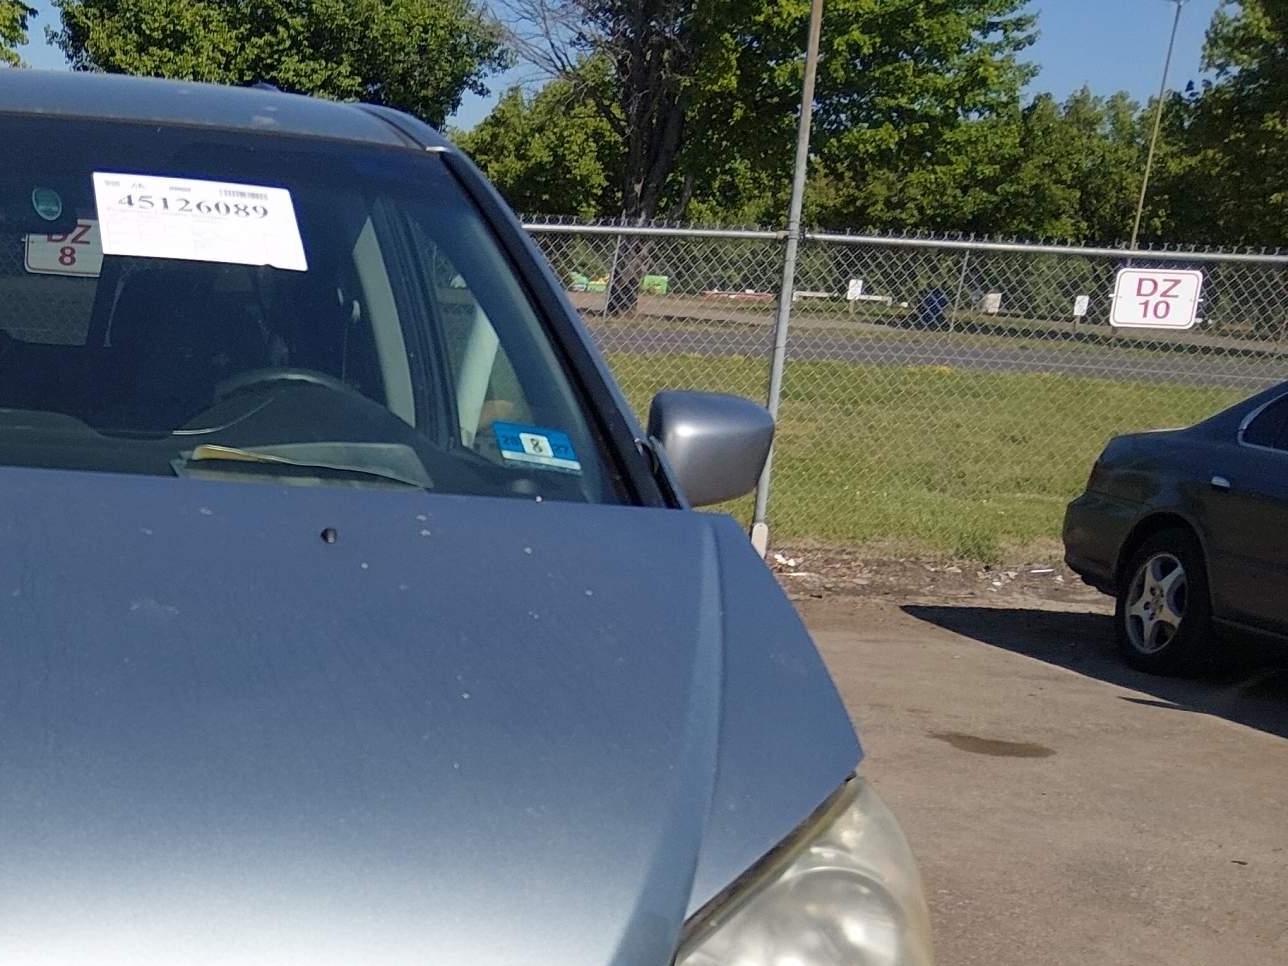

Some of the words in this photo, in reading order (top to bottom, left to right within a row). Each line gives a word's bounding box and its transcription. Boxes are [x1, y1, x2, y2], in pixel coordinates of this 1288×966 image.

[118, 194, 268, 218] 45126089
[58, 246, 77, 266] 8
[1136, 278, 1182, 298] DZ
[1138, 300, 1171, 319] 10
[530, 438, 543, 453] 8
